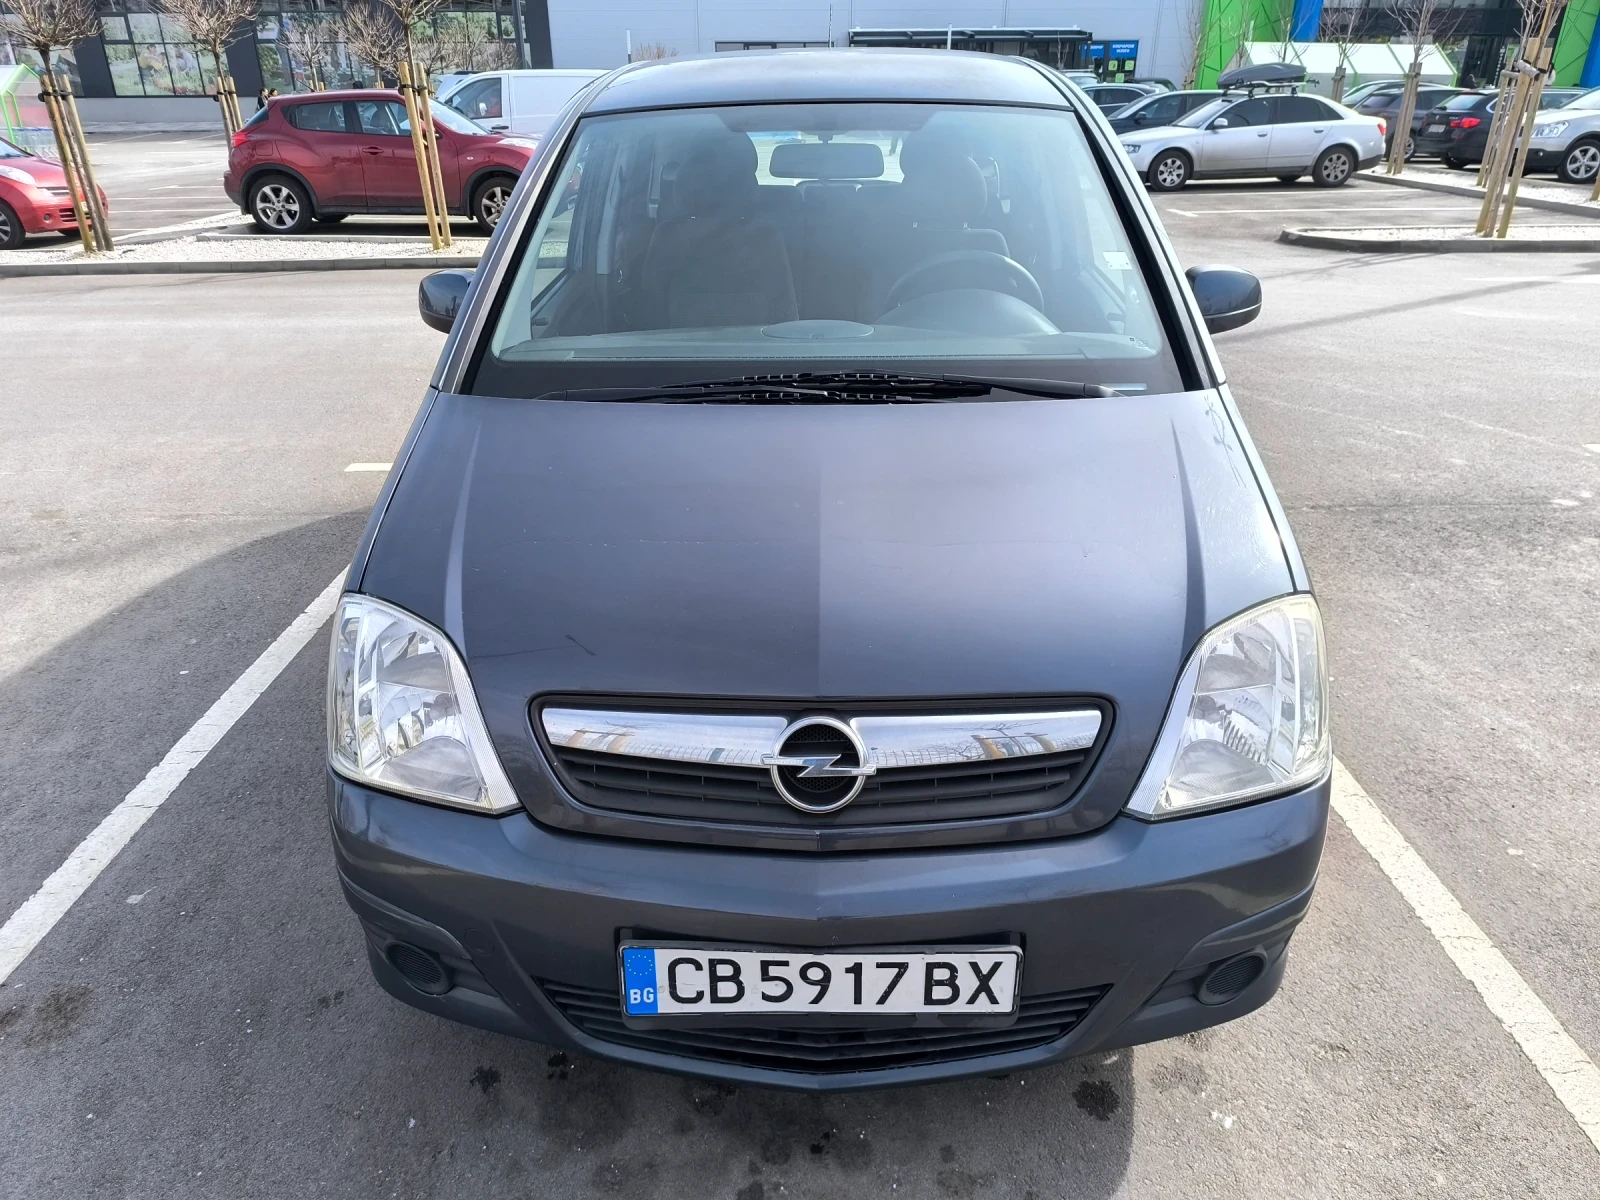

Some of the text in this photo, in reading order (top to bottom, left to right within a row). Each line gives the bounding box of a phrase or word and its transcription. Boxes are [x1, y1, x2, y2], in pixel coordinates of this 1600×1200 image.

[629, 988, 655, 1004] BG
[667, 957, 1004, 1006] CB 5917 BX
